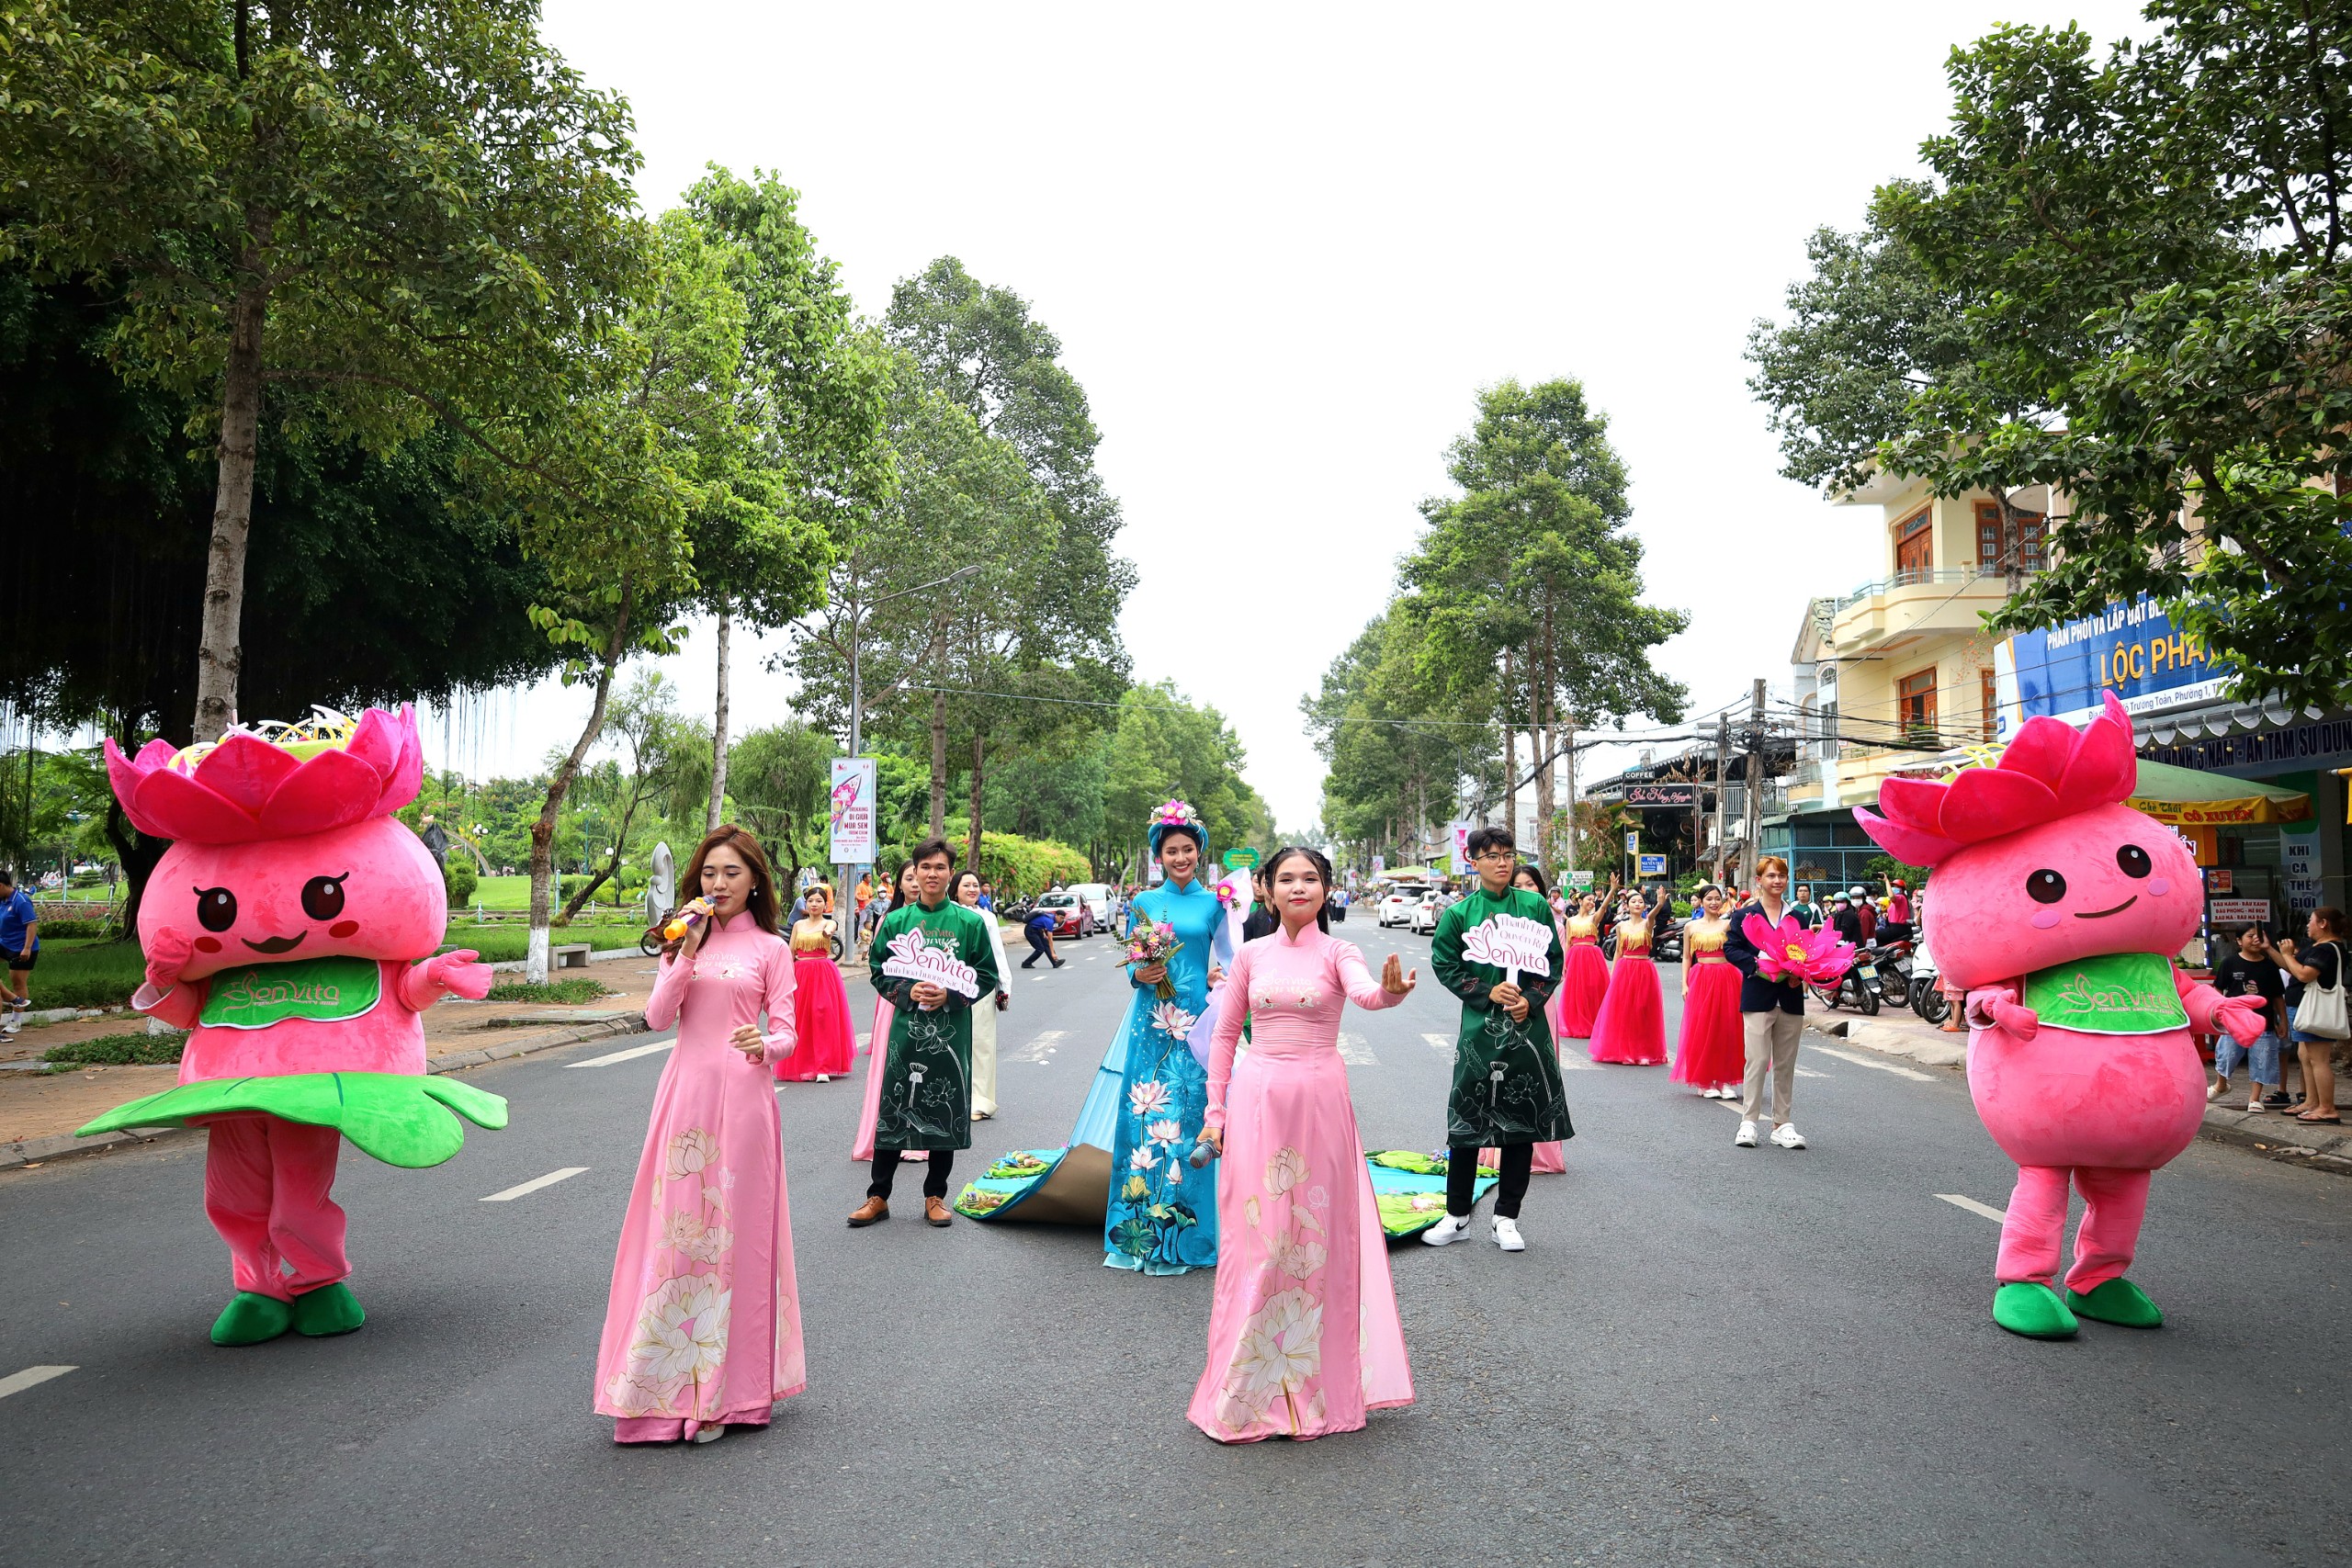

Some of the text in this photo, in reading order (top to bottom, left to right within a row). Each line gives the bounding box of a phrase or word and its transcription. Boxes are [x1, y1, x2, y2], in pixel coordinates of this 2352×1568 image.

[2100, 640, 2144, 691] LỘC
[2175, 687, 2203, 702] Phường
[2245, 735, 2264, 763] AN
[2139, 801, 2181, 813] Chè Thái
[2184, 809, 2203, 822] CÔ
[2289, 845, 2310, 856] KHI
[1500, 917, 1529, 931] Thanh
